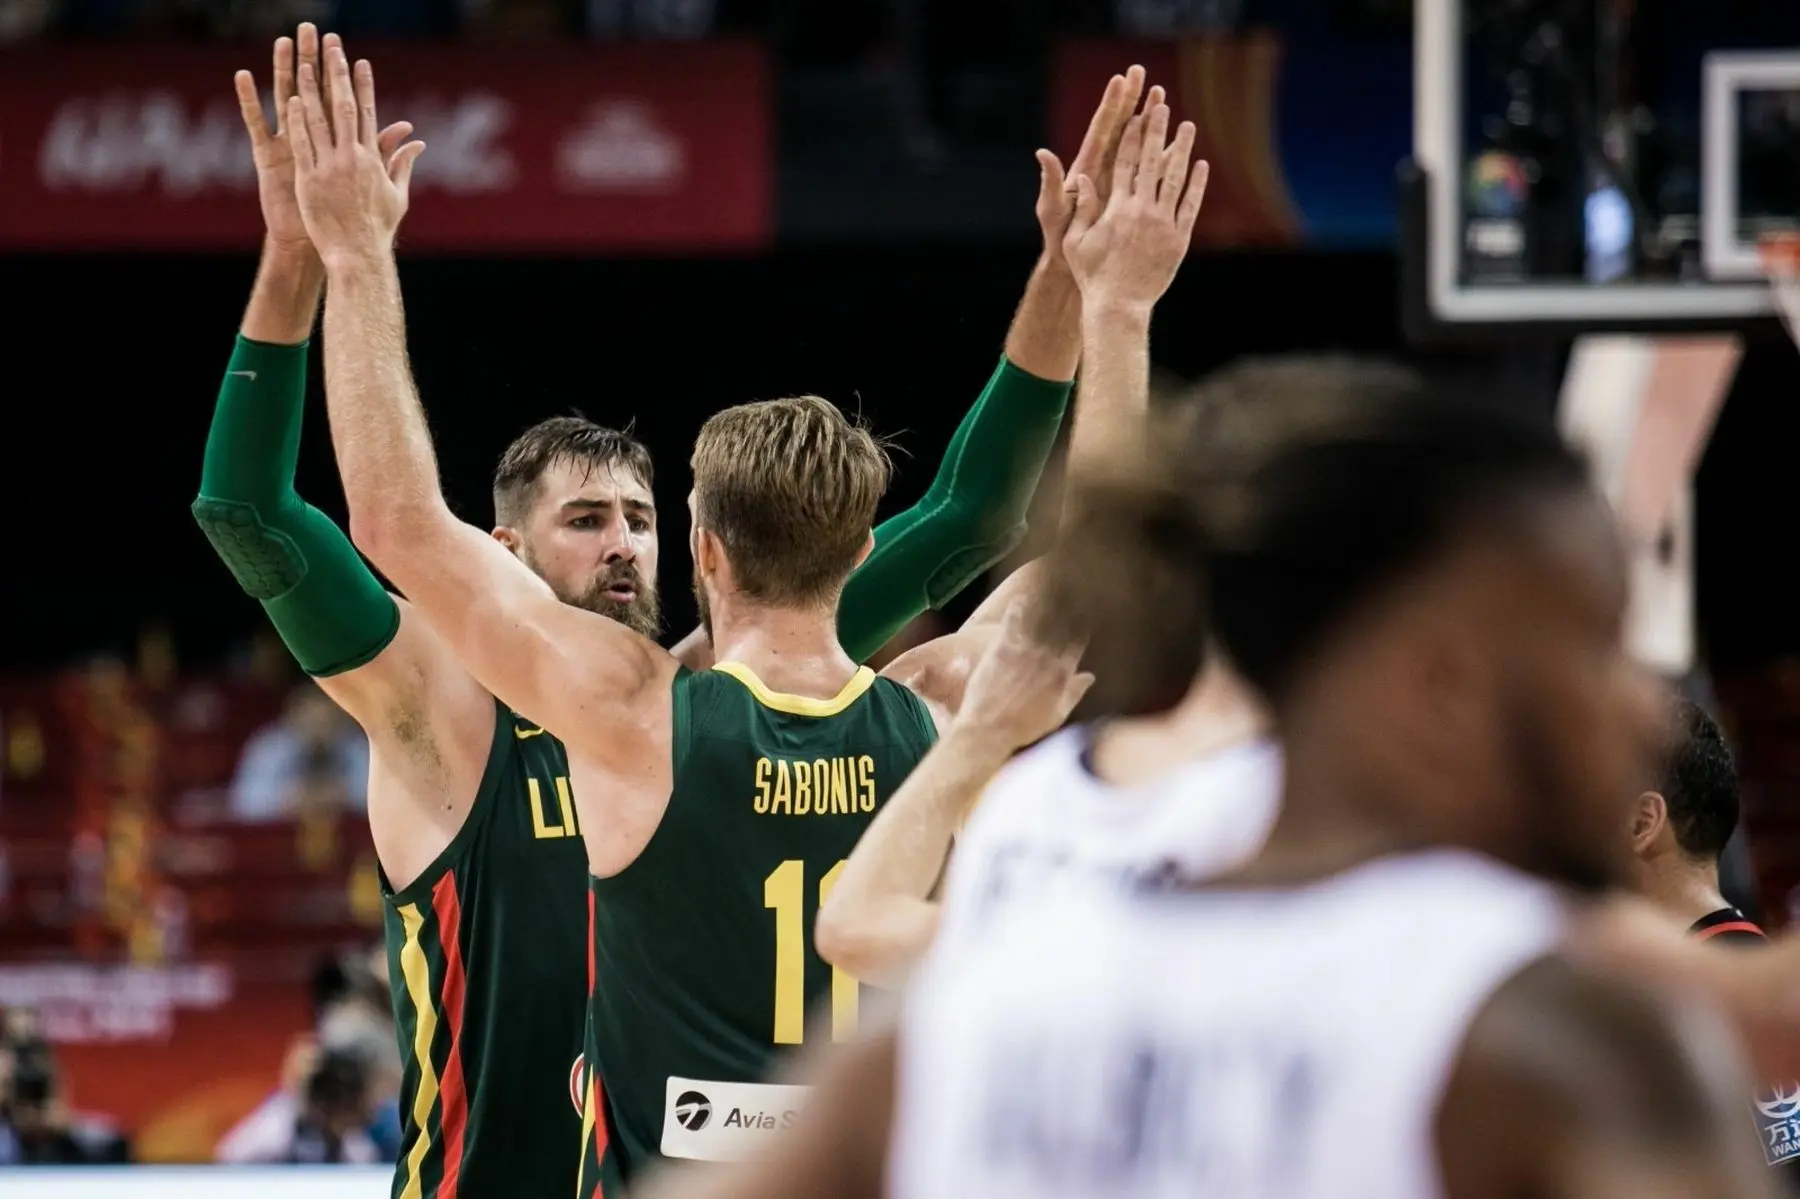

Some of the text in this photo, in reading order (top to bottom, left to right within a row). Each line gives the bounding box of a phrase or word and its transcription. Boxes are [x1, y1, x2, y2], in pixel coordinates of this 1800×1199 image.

[528, 776, 583, 839] LI
[754, 755, 876, 815] SABONIS
[723, 1107, 776, 1129] Avia
